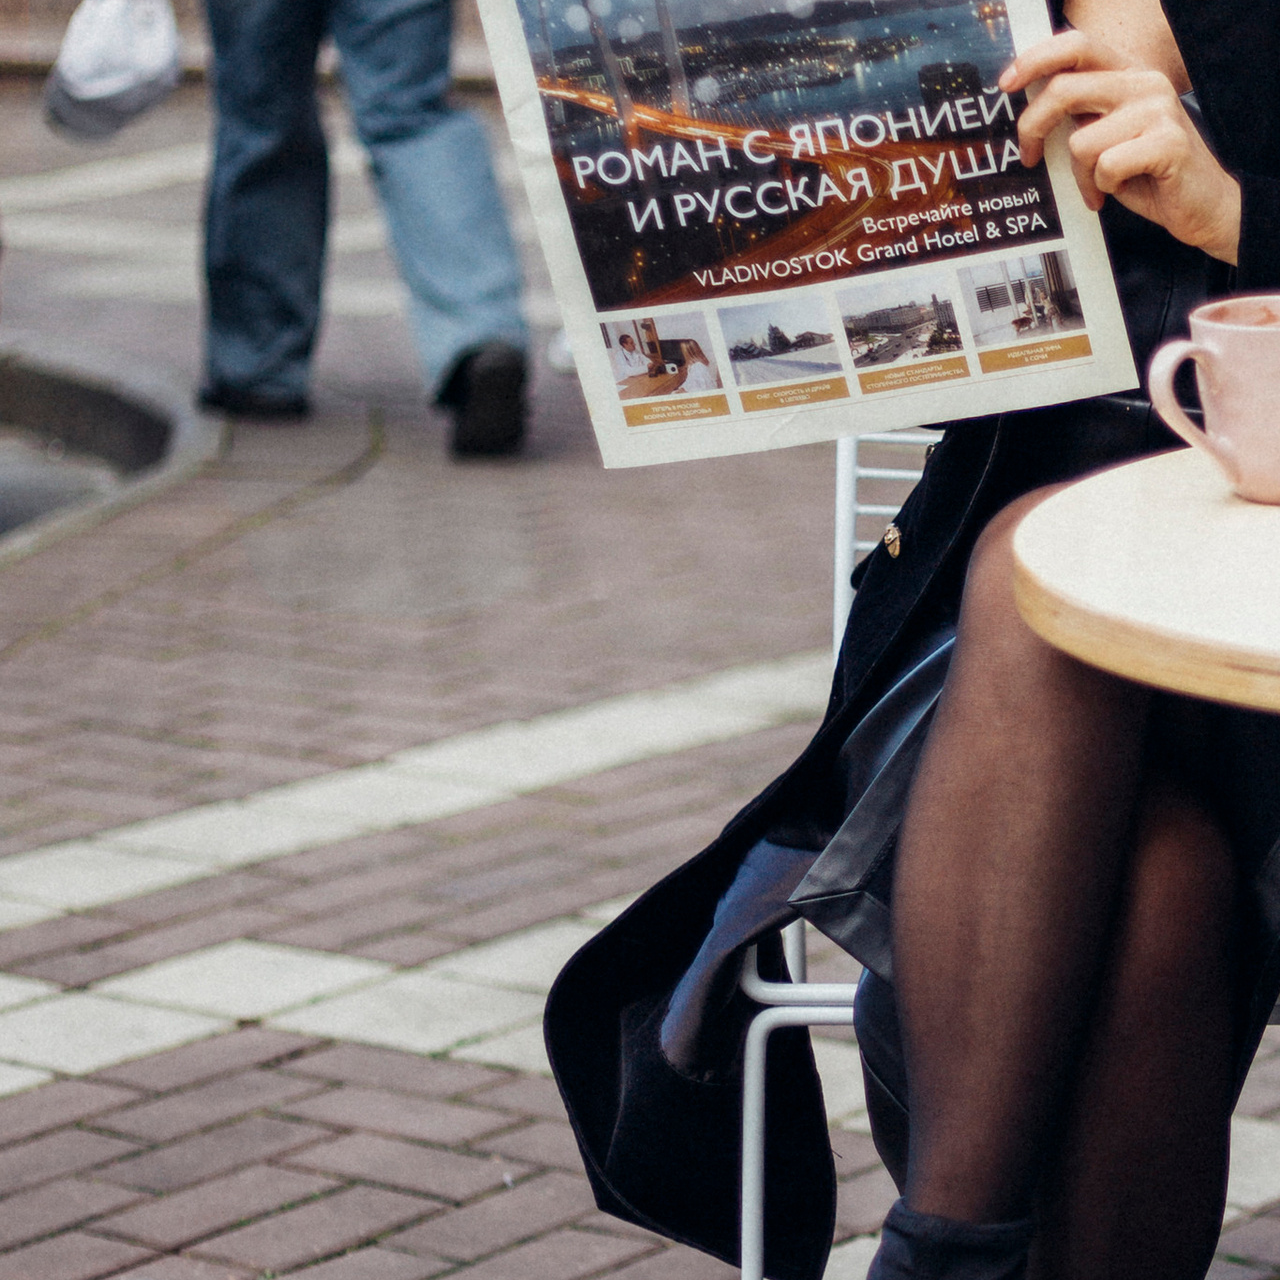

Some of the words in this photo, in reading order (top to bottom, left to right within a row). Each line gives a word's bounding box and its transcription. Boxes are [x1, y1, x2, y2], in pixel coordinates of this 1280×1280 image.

[573, 136, 730, 188] РОМАН
[743, 130, 775, 163] С
[790, 87, 1013, 158] ЯПОНИЕЙ
[628, 199, 663, 232] И
[674, 168, 873, 226] РУССКАЯ
[891, 140, 1020, 199] ДУША
[863, 204, 972, 233] Встречайте
[978, 189, 1040, 212] новый
[692, 248, 852, 287] VLADIVOSTOK
[858, 236, 918, 261] Grand
[924, 225, 979, 249] Hotel
[987, 222, 1000, 238] &
[1005, 213, 1048, 234] SPA
